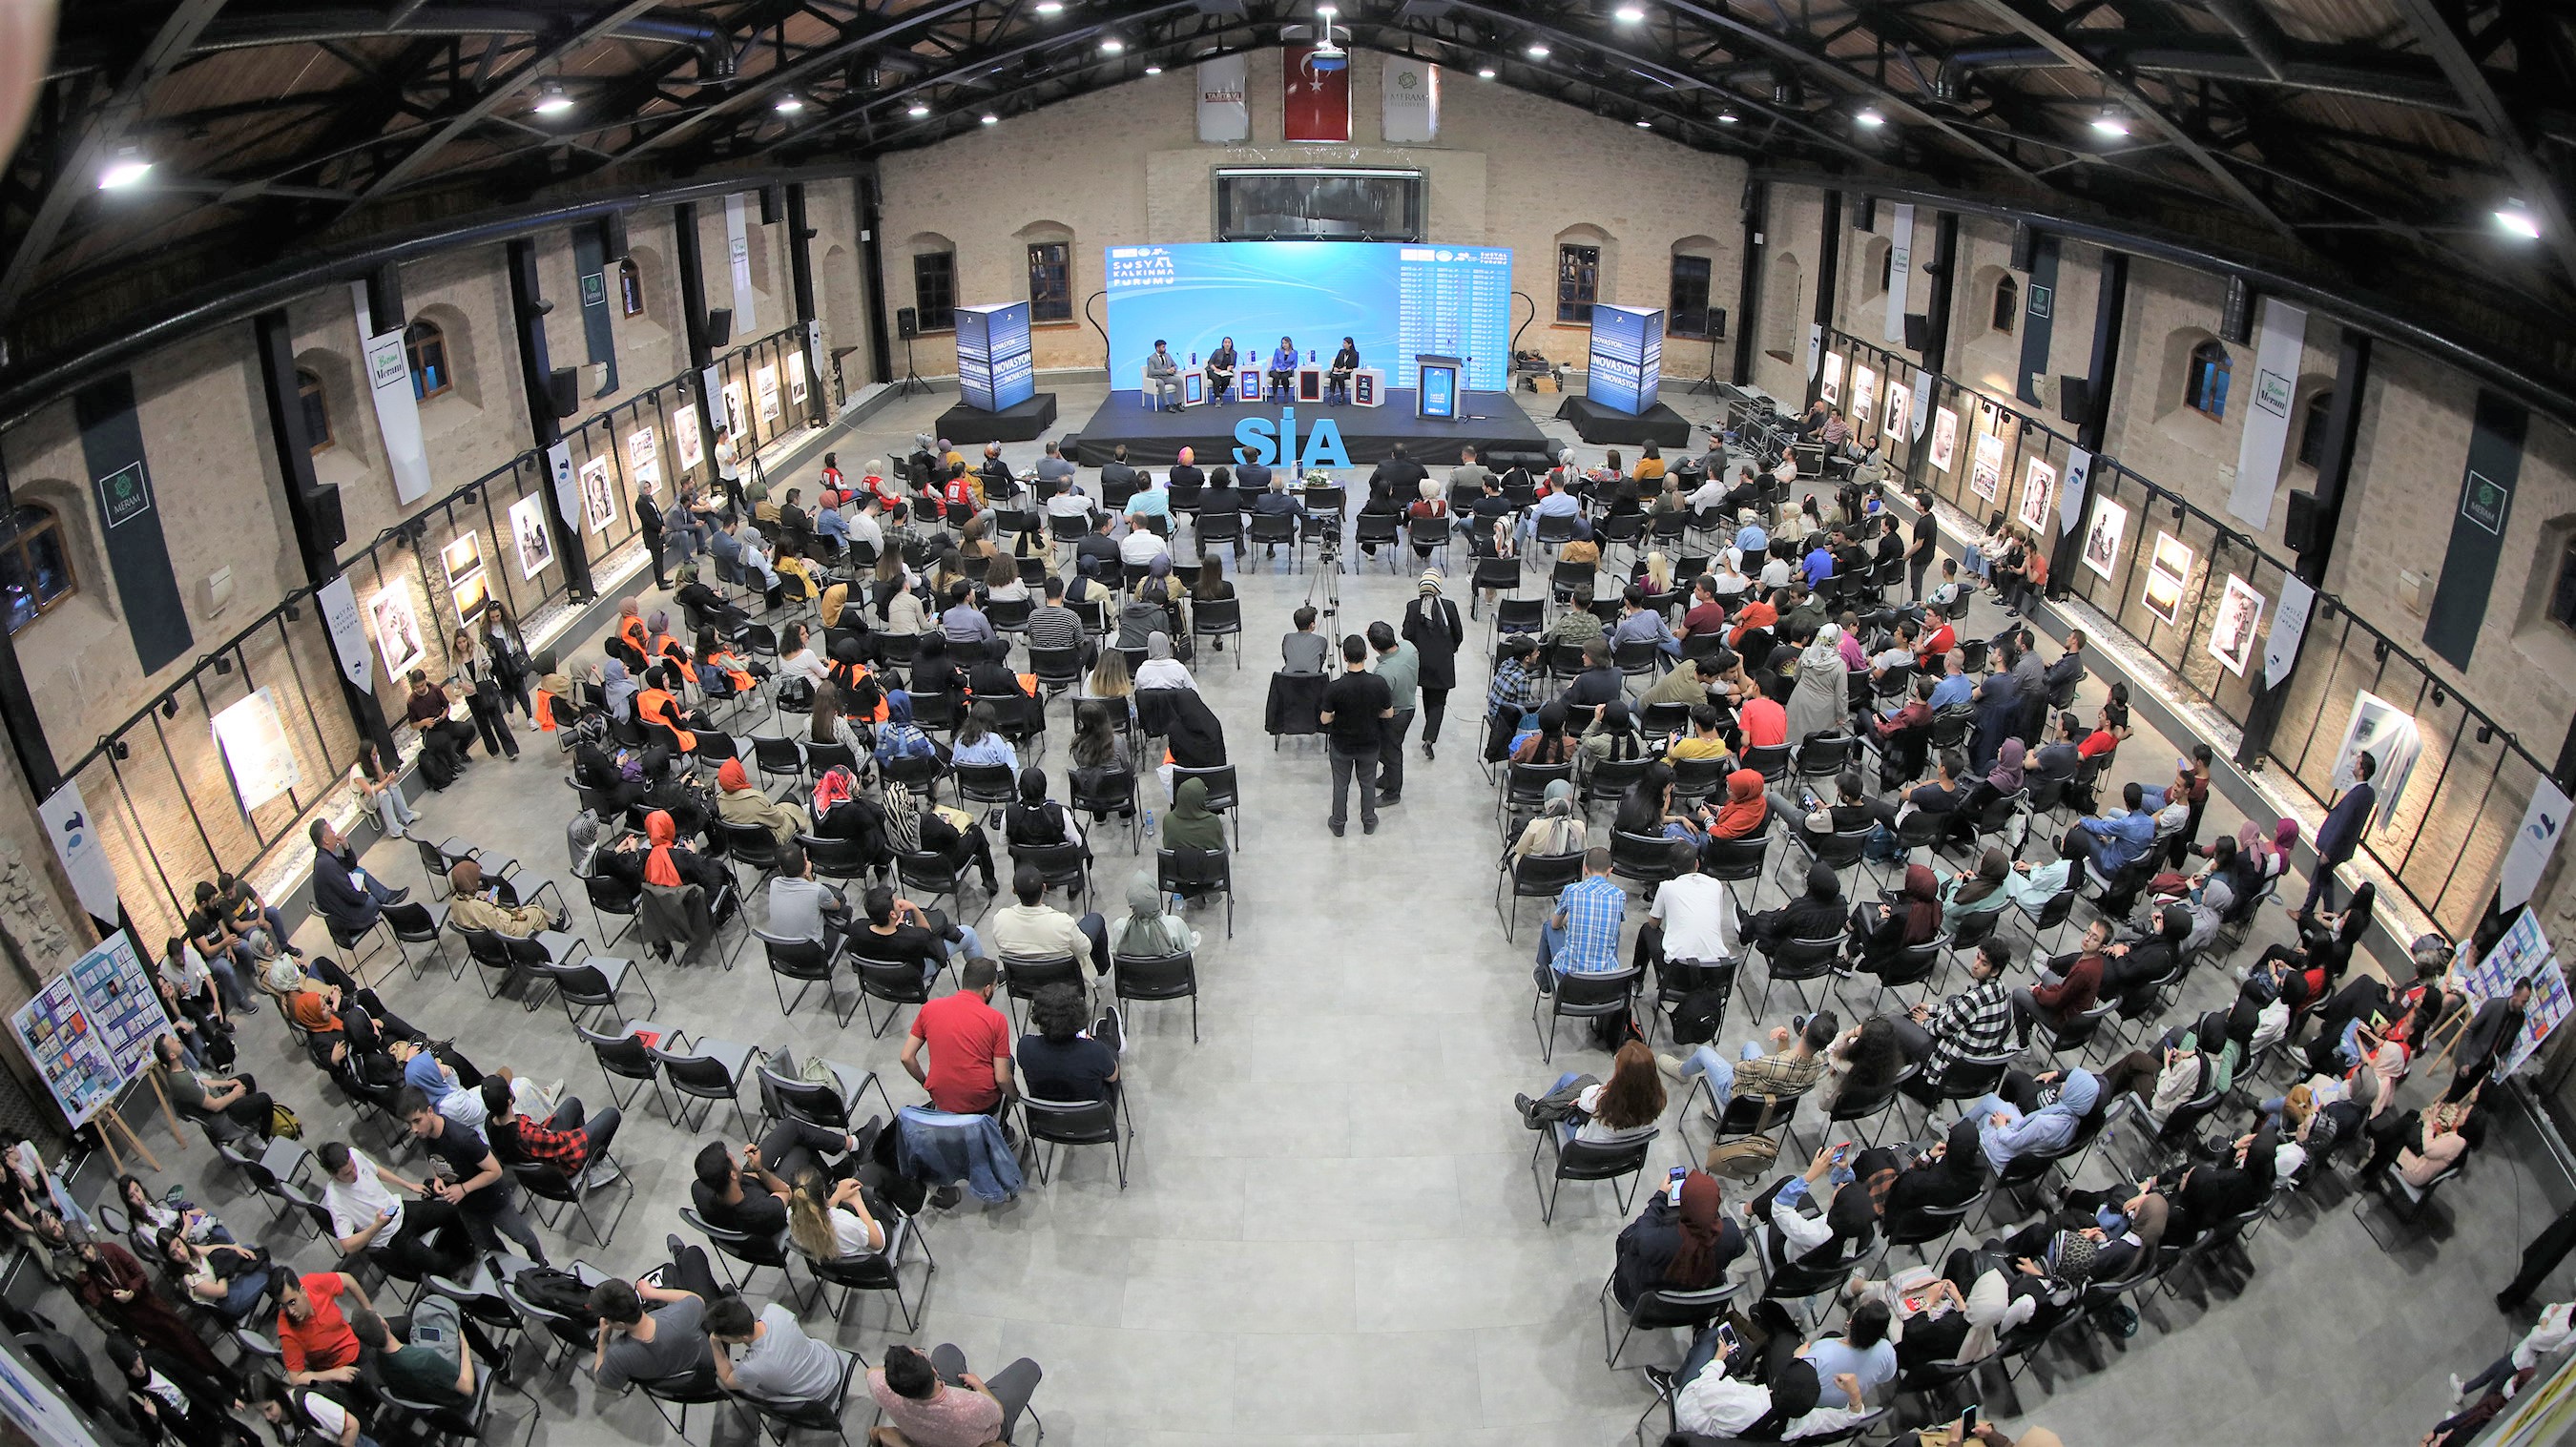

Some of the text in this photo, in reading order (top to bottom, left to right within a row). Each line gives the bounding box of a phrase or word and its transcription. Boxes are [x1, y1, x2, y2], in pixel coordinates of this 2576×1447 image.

[1112, 268, 1174, 278] KALKINMA
[992, 352, 1031, 375] İNOVASYON
[1590, 352, 1640, 378] İNOVASYON
[114, 493, 141, 514] MERAM
[2471, 501, 2495, 522] MERAM
